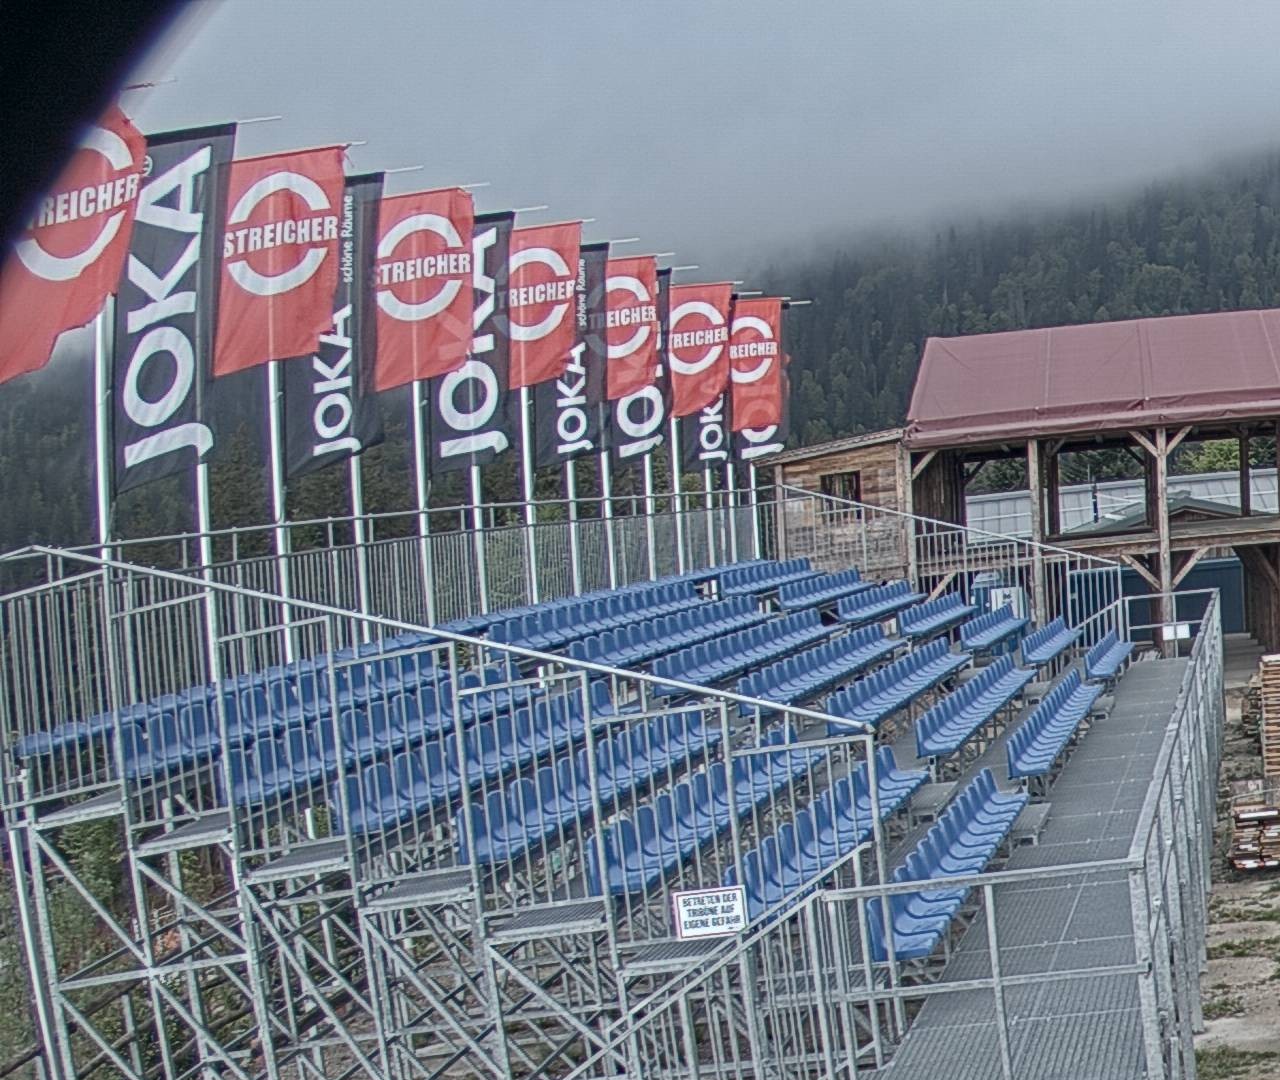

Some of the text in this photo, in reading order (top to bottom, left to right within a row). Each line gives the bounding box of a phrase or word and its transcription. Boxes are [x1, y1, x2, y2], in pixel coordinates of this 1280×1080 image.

[30, 173, 140, 230] REICHER
[224, 215, 338, 258] STREICHER
[124, 145, 214, 469] JOKA
[510, 280, 576, 307] REICHER
[607, 306, 657, 328] EICHER
[730, 341, 778, 360] REICHER
[313, 303, 363, 457] JOKA
[556, 342, 594, 454] JOKA
[699, 393, 727, 460] JOK
